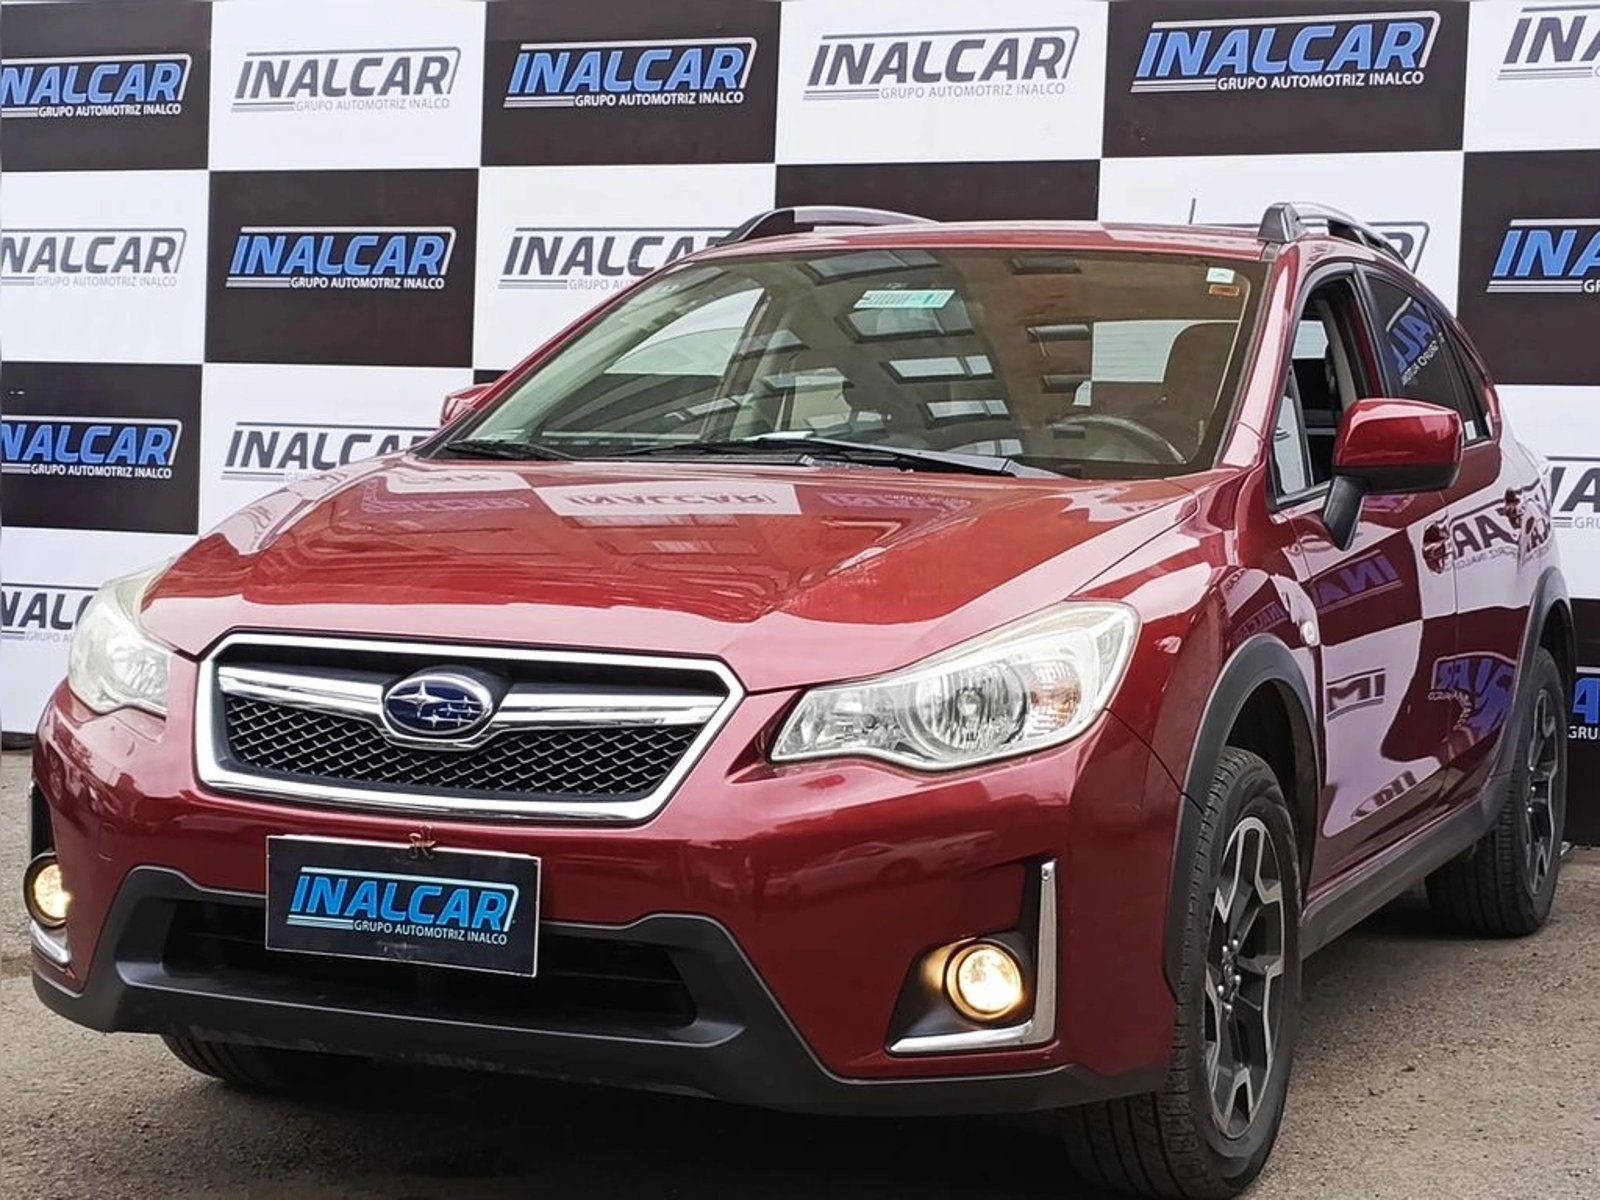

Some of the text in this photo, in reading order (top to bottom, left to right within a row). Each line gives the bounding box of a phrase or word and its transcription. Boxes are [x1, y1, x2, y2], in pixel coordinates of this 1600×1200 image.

[1135, 22, 1426, 78] INALCAR
[1502, 15, 1600, 64] IN
[507, 46, 744, 94] INALCAR
[808, 37, 1068, 88] INALCAR
[235, 56, 451, 99] INALCAR
[1217, 70, 1424, 91] GRUPO AUTOMOTRIZ INALCO
[575, 90, 744, 107] GRUPO AUTOMOTRIZ INALCO
[880, 82, 1066, 99] GRUPO AUTOMOTRIZ INALCO
[38, 102, 182, 118] GRUPO AUTOMOTRIZ INALCO
[296, 98, 450, 112] GRUPO AUTOMOTRIZ INALCO
[229, 234, 446, 276] INALCAR
[502, 236, 732, 276] INALCA
[35, 276, 177, 288] GRUPO AUTOMOTRIZ INALCO
[290, 277, 445, 290] GRUPO AUTOMOTRIZ INALCO
[568, 279, 609, 290] GRUPO
[30, 463, 172, 480] GRUPO AUTOMOTRIZ INALCO
[290, 875, 508, 931] INALCAR
[353, 919, 508, 946] GRUPO AUTOMOTRIZ INALCO
